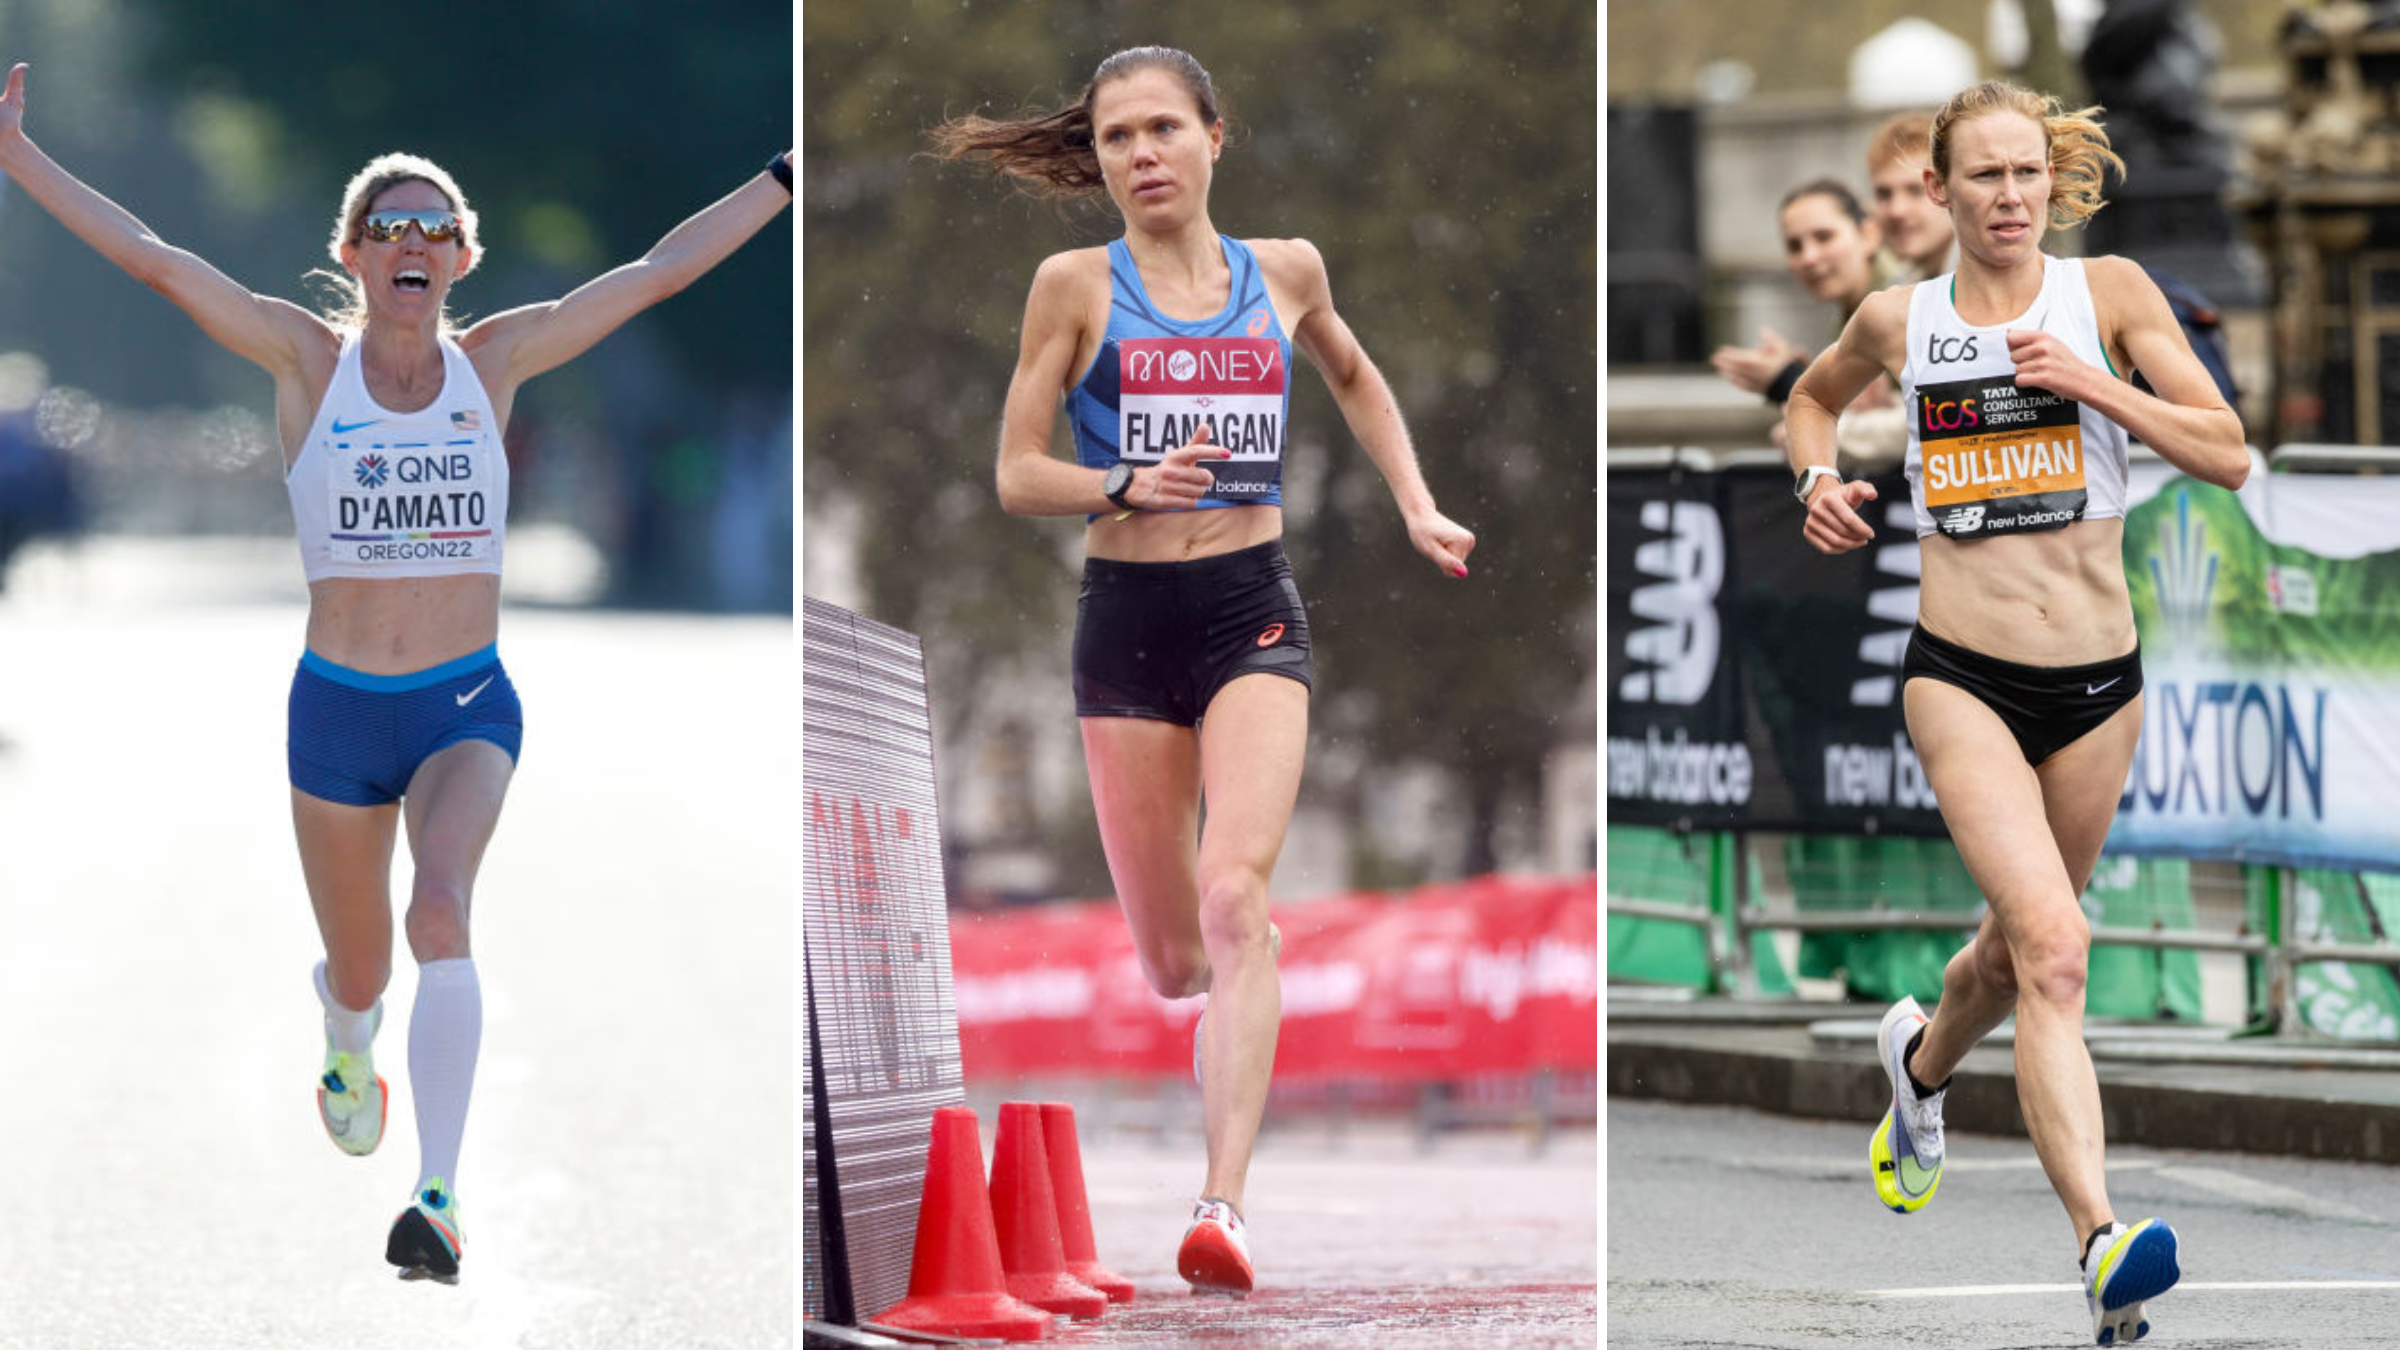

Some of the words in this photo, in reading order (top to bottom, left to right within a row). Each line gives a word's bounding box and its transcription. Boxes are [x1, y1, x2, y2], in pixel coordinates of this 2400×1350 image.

[1929, 333, 1978, 365] tcs
[1982, 386, 2018, 400] TATA
[1983, 395, 2065, 413] CONSULTANCY
[1924, 395, 1979, 431] tcs
[1984, 410, 2038, 425] SERVICES
[397, 454, 472, 483] QNB
[1928, 439, 2077, 490] SULLIVAN
[339, 491, 485, 530] D'AMATO
[1987, 517, 2016, 530] new
[2018, 509, 2075, 527] balance
[357, 541, 473, 561] OREGON22
[2118, 682, 2328, 823] UXTON
[1824, 743, 1892, 807] new
